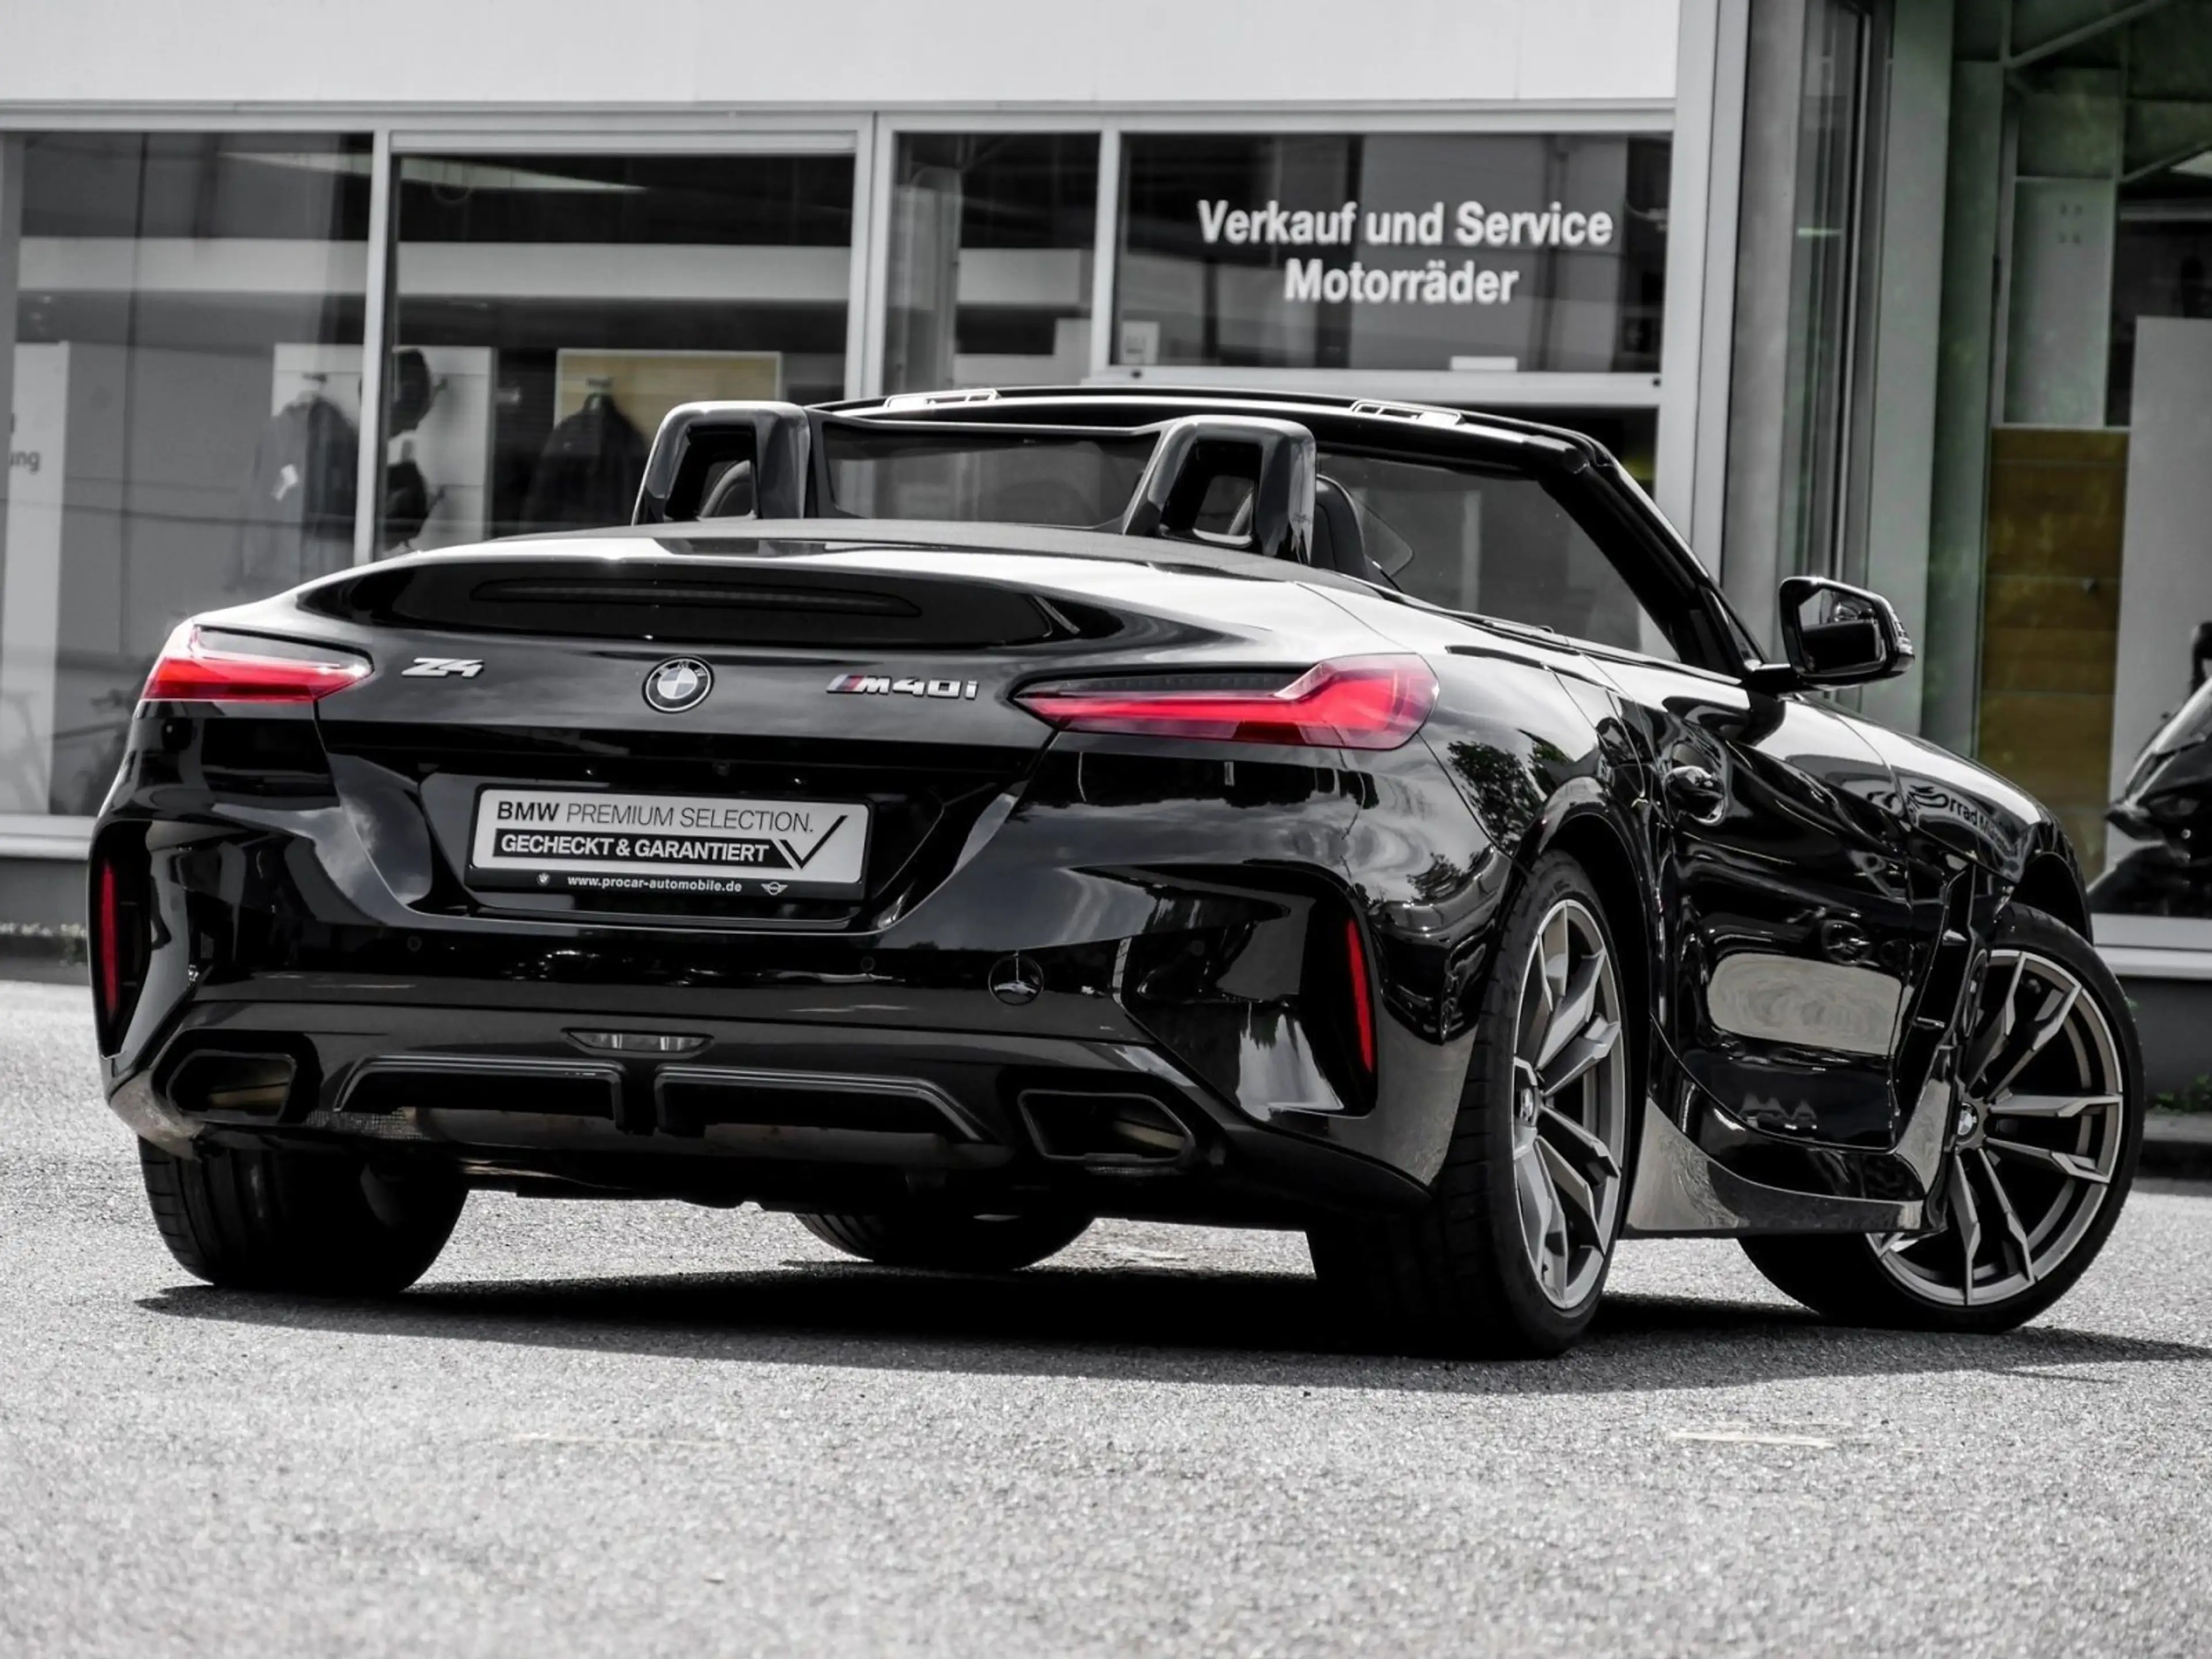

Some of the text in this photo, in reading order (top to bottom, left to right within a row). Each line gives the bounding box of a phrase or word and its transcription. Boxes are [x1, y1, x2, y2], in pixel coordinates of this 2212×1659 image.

[1198, 199, 1613, 247] Verkauf und Service
[1284, 257, 1520, 304] Motorräder
[402, 657, 484, 679] Z4
[827, 673, 979, 700] M40i
[497, 801, 814, 834] BMW PREMIUM SELECTION.
[501, 834, 770, 863] GECHECKT & GARANTIERT
[567, 875, 743, 893] www.procar-automobile.de
